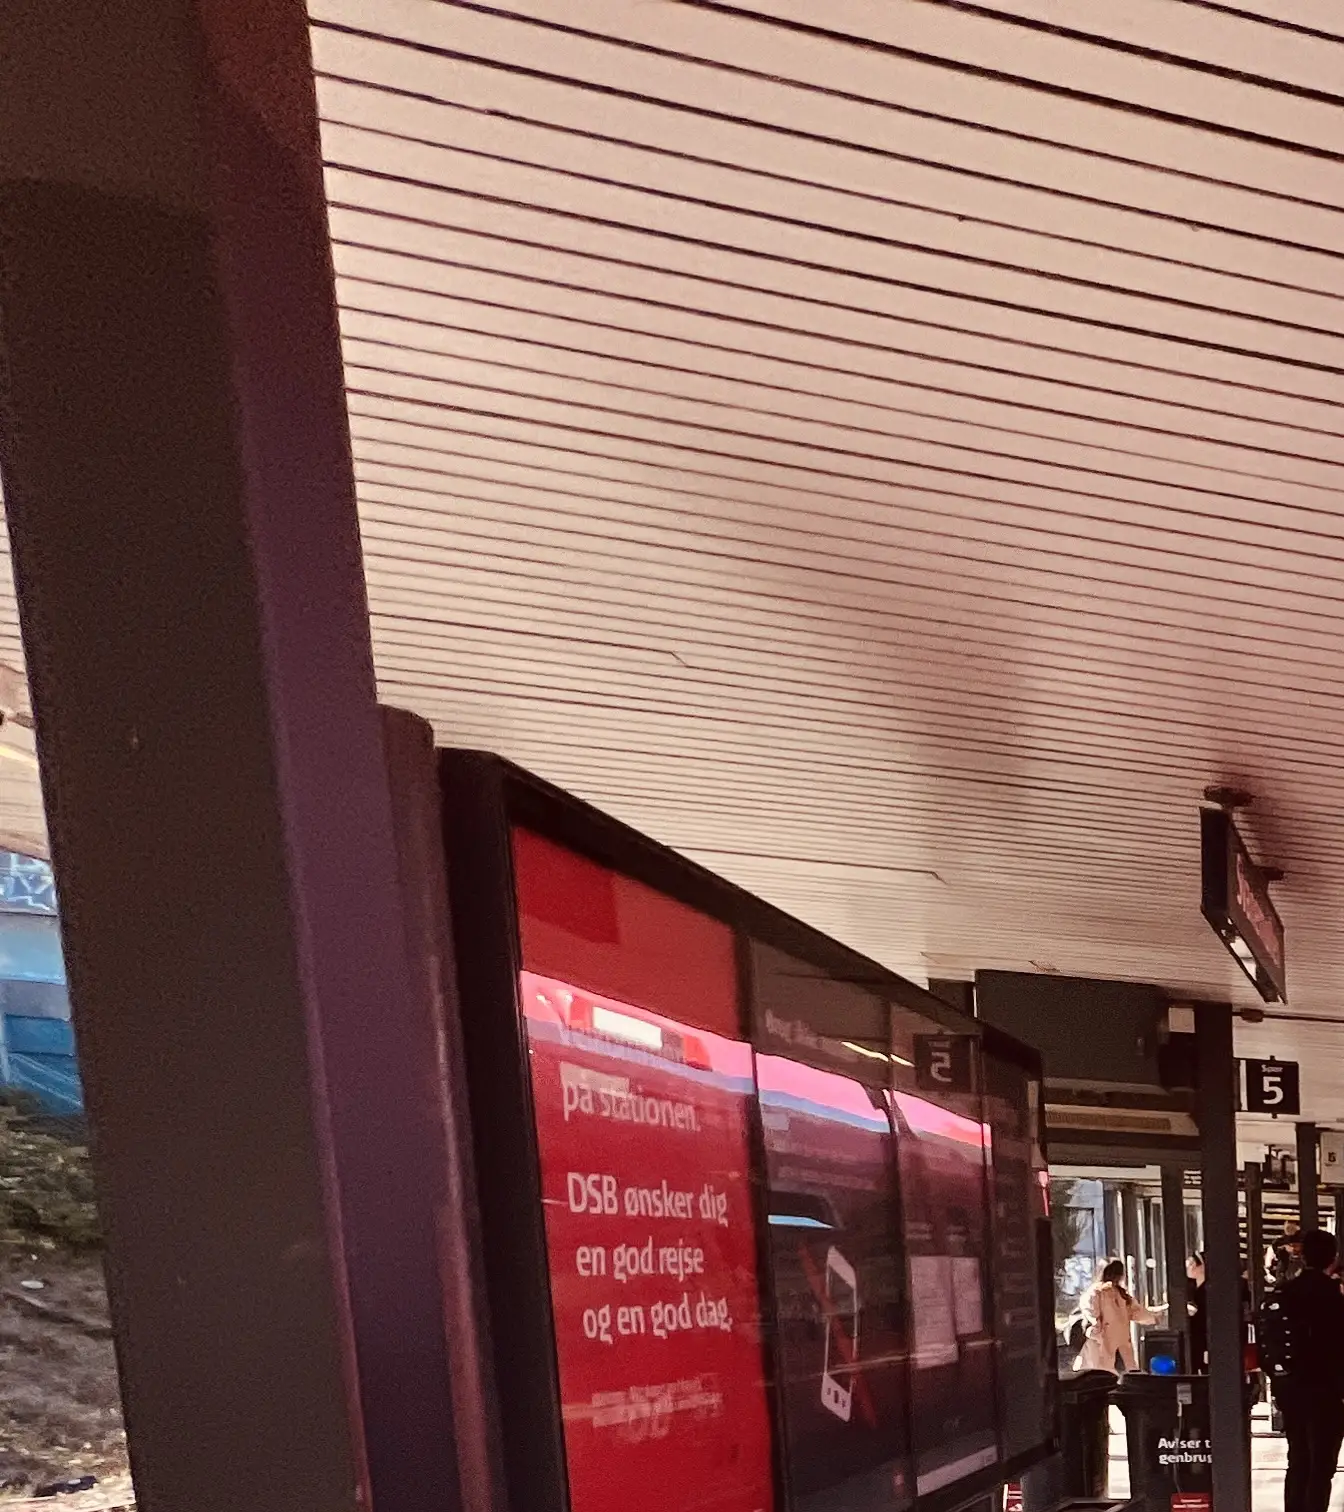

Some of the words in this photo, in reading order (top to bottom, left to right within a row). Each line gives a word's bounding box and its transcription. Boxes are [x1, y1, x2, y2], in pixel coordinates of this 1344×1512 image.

[600, 1087, 701, 1132] stationen.
[1263, 1076, 1283, 1104] 5
[567, 1172, 618, 1214] DSB
[624, 1179, 693, 1219] ønsker
[700, 1183, 728, 1227] dig
[576, 1245, 606, 1276] en
[613, 1235, 654, 1283] god
[659, 1238, 704, 1283] rejse
[583, 1304, 613, 1344] og
[617, 1305, 645, 1336] en
[651, 1292, 693, 1340] god
[696, 1292, 733, 1333] dag.
